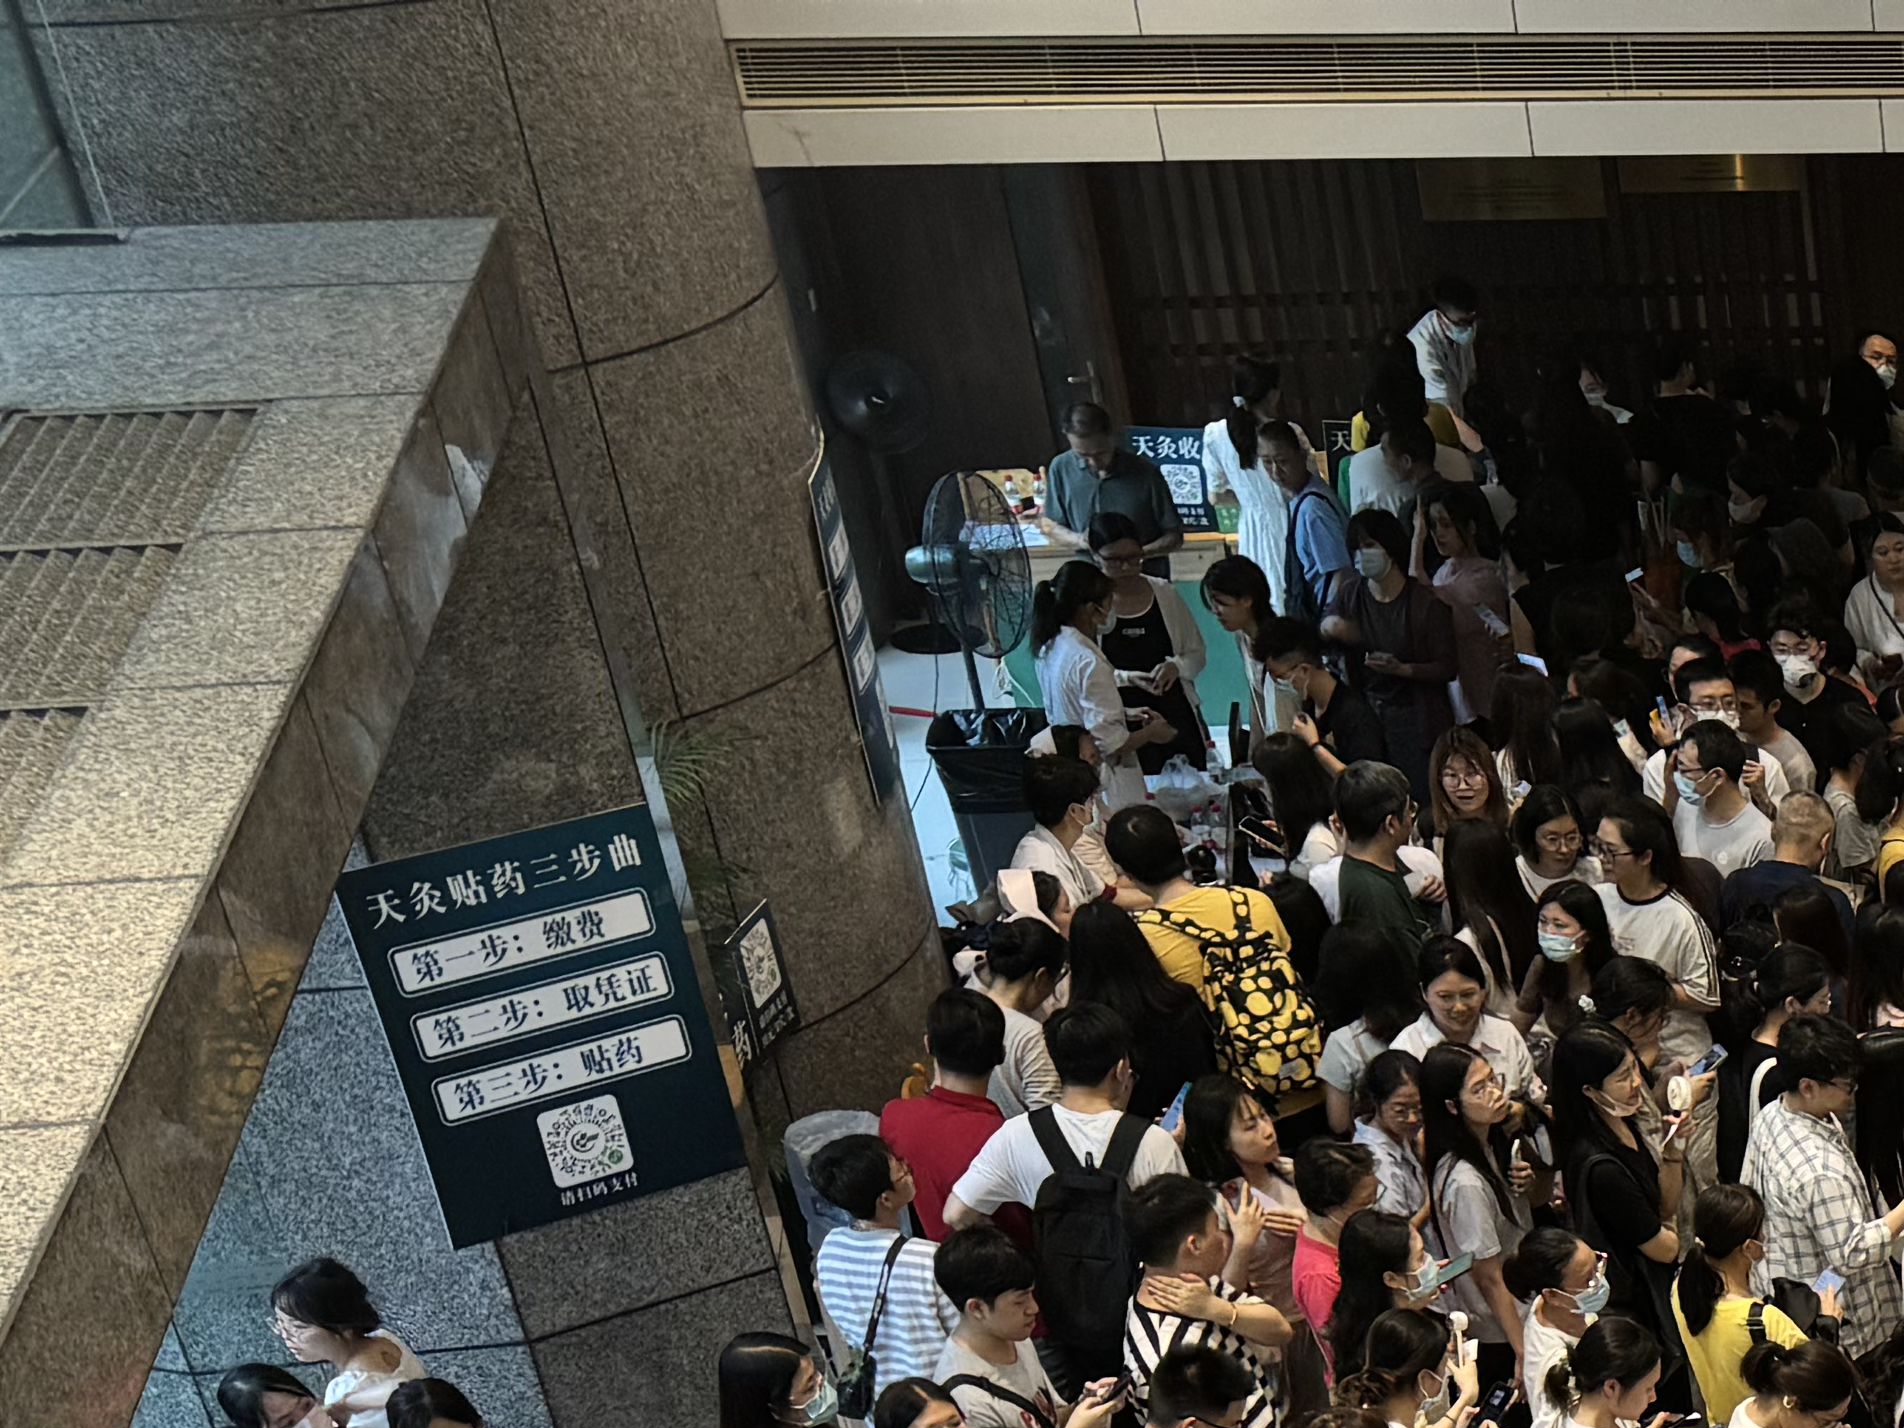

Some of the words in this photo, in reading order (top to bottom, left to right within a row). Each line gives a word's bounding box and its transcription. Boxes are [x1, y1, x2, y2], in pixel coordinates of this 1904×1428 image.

[366, 833, 643, 931] 天灸贴药三步曲
[410, 910, 606, 985] 第一步：缴费
[432, 965, 659, 1049] 第二步：取凭证
[453, 1036, 644, 1112] 第三步：贴药
